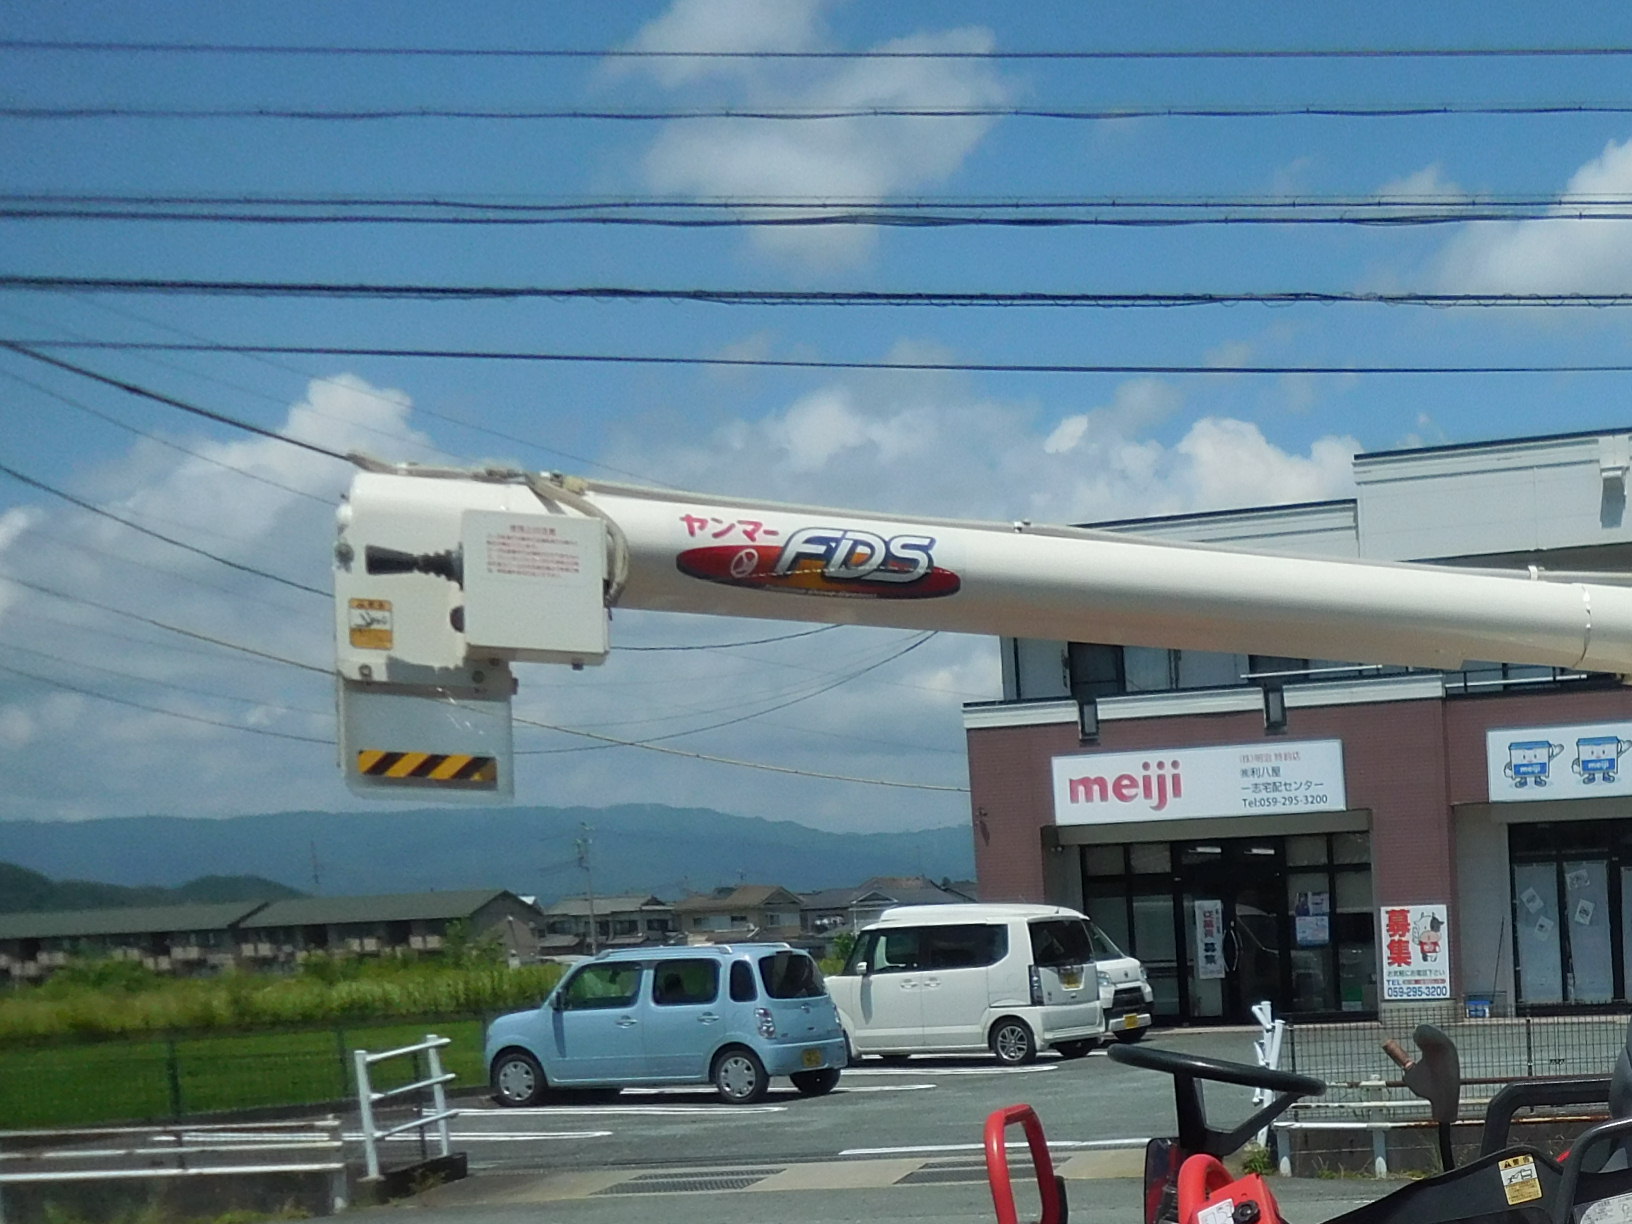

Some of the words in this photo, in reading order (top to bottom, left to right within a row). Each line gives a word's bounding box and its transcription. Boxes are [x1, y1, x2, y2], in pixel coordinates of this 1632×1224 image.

[680, 513, 780, 543] ヤンマー
[775, 526, 936, 584] FDS
[1519, 765, 1541, 775] meiji
[1587, 760, 1609, 770] meiji
[1069, 759, 1182, 812] meiji
[1386, 909, 1412, 967] 募集
[1387, 986, 1448, 997] 059-295-3200
